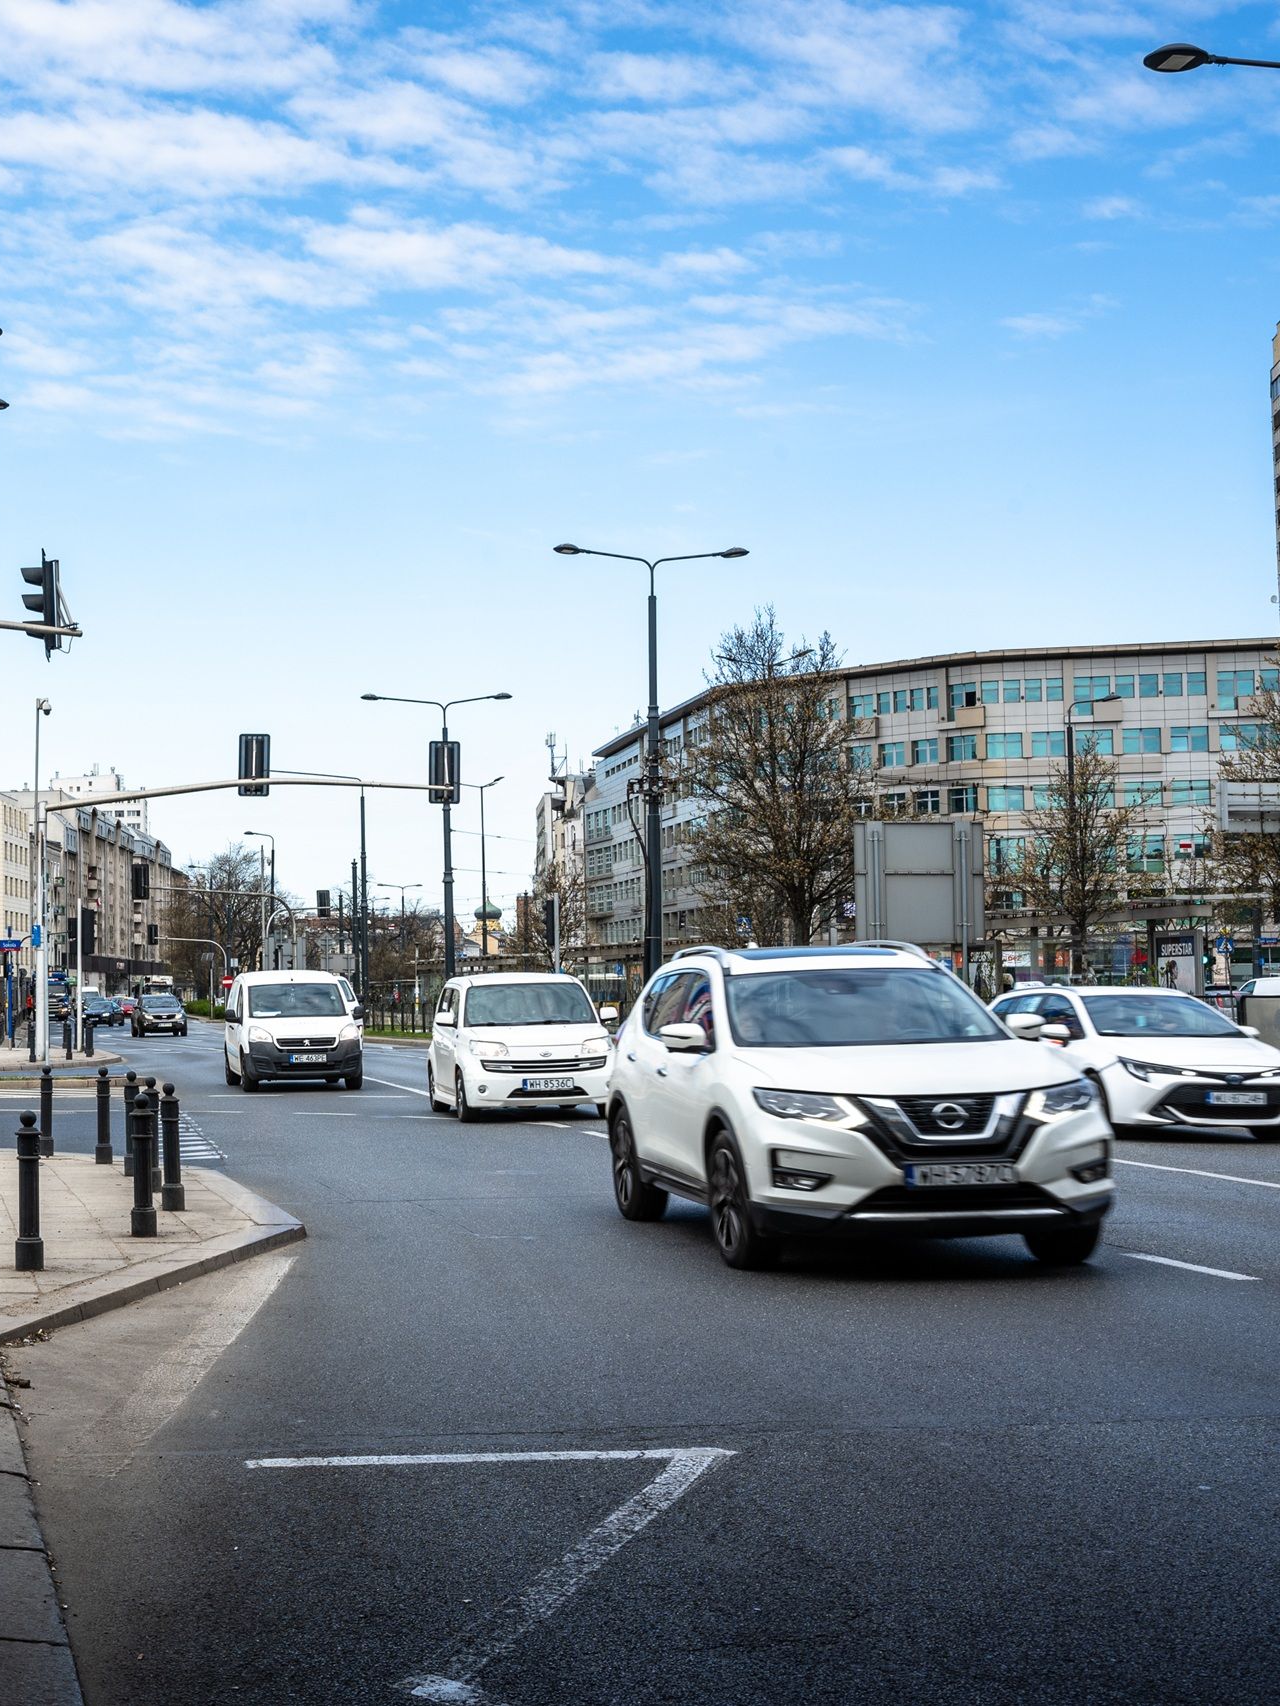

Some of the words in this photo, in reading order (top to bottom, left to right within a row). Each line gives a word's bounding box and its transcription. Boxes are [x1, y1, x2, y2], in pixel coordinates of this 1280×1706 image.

[1161, 943, 1193, 956] SUPERSTAR
[529, 1080, 541, 1089] WH
[543, 1079, 571, 1088] 8536C
